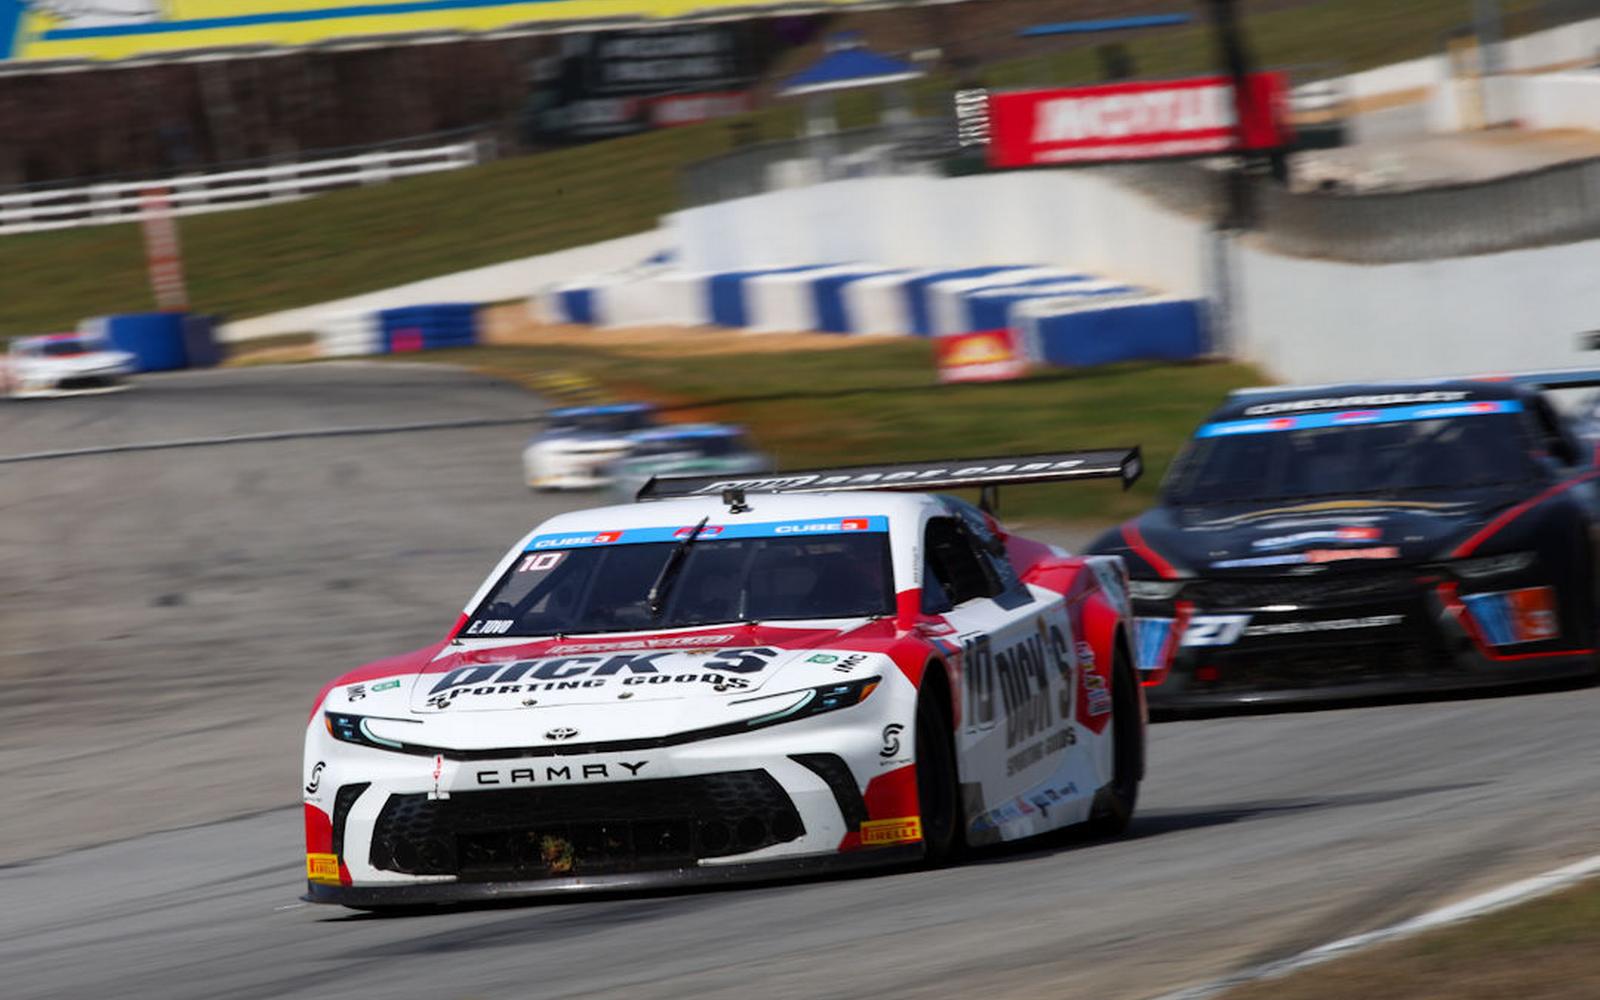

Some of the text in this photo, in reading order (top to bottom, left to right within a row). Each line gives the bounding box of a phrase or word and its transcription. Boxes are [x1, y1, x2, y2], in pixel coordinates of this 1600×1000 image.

[519, 553, 563, 573] 10
[428, 648, 777, 695] DICK'S
[426, 677, 606, 706] SPORTING
[622, 672, 750, 692] GOODS
[476, 761, 649, 784] CAMRY
[864, 821, 917, 842] PIRELLI
